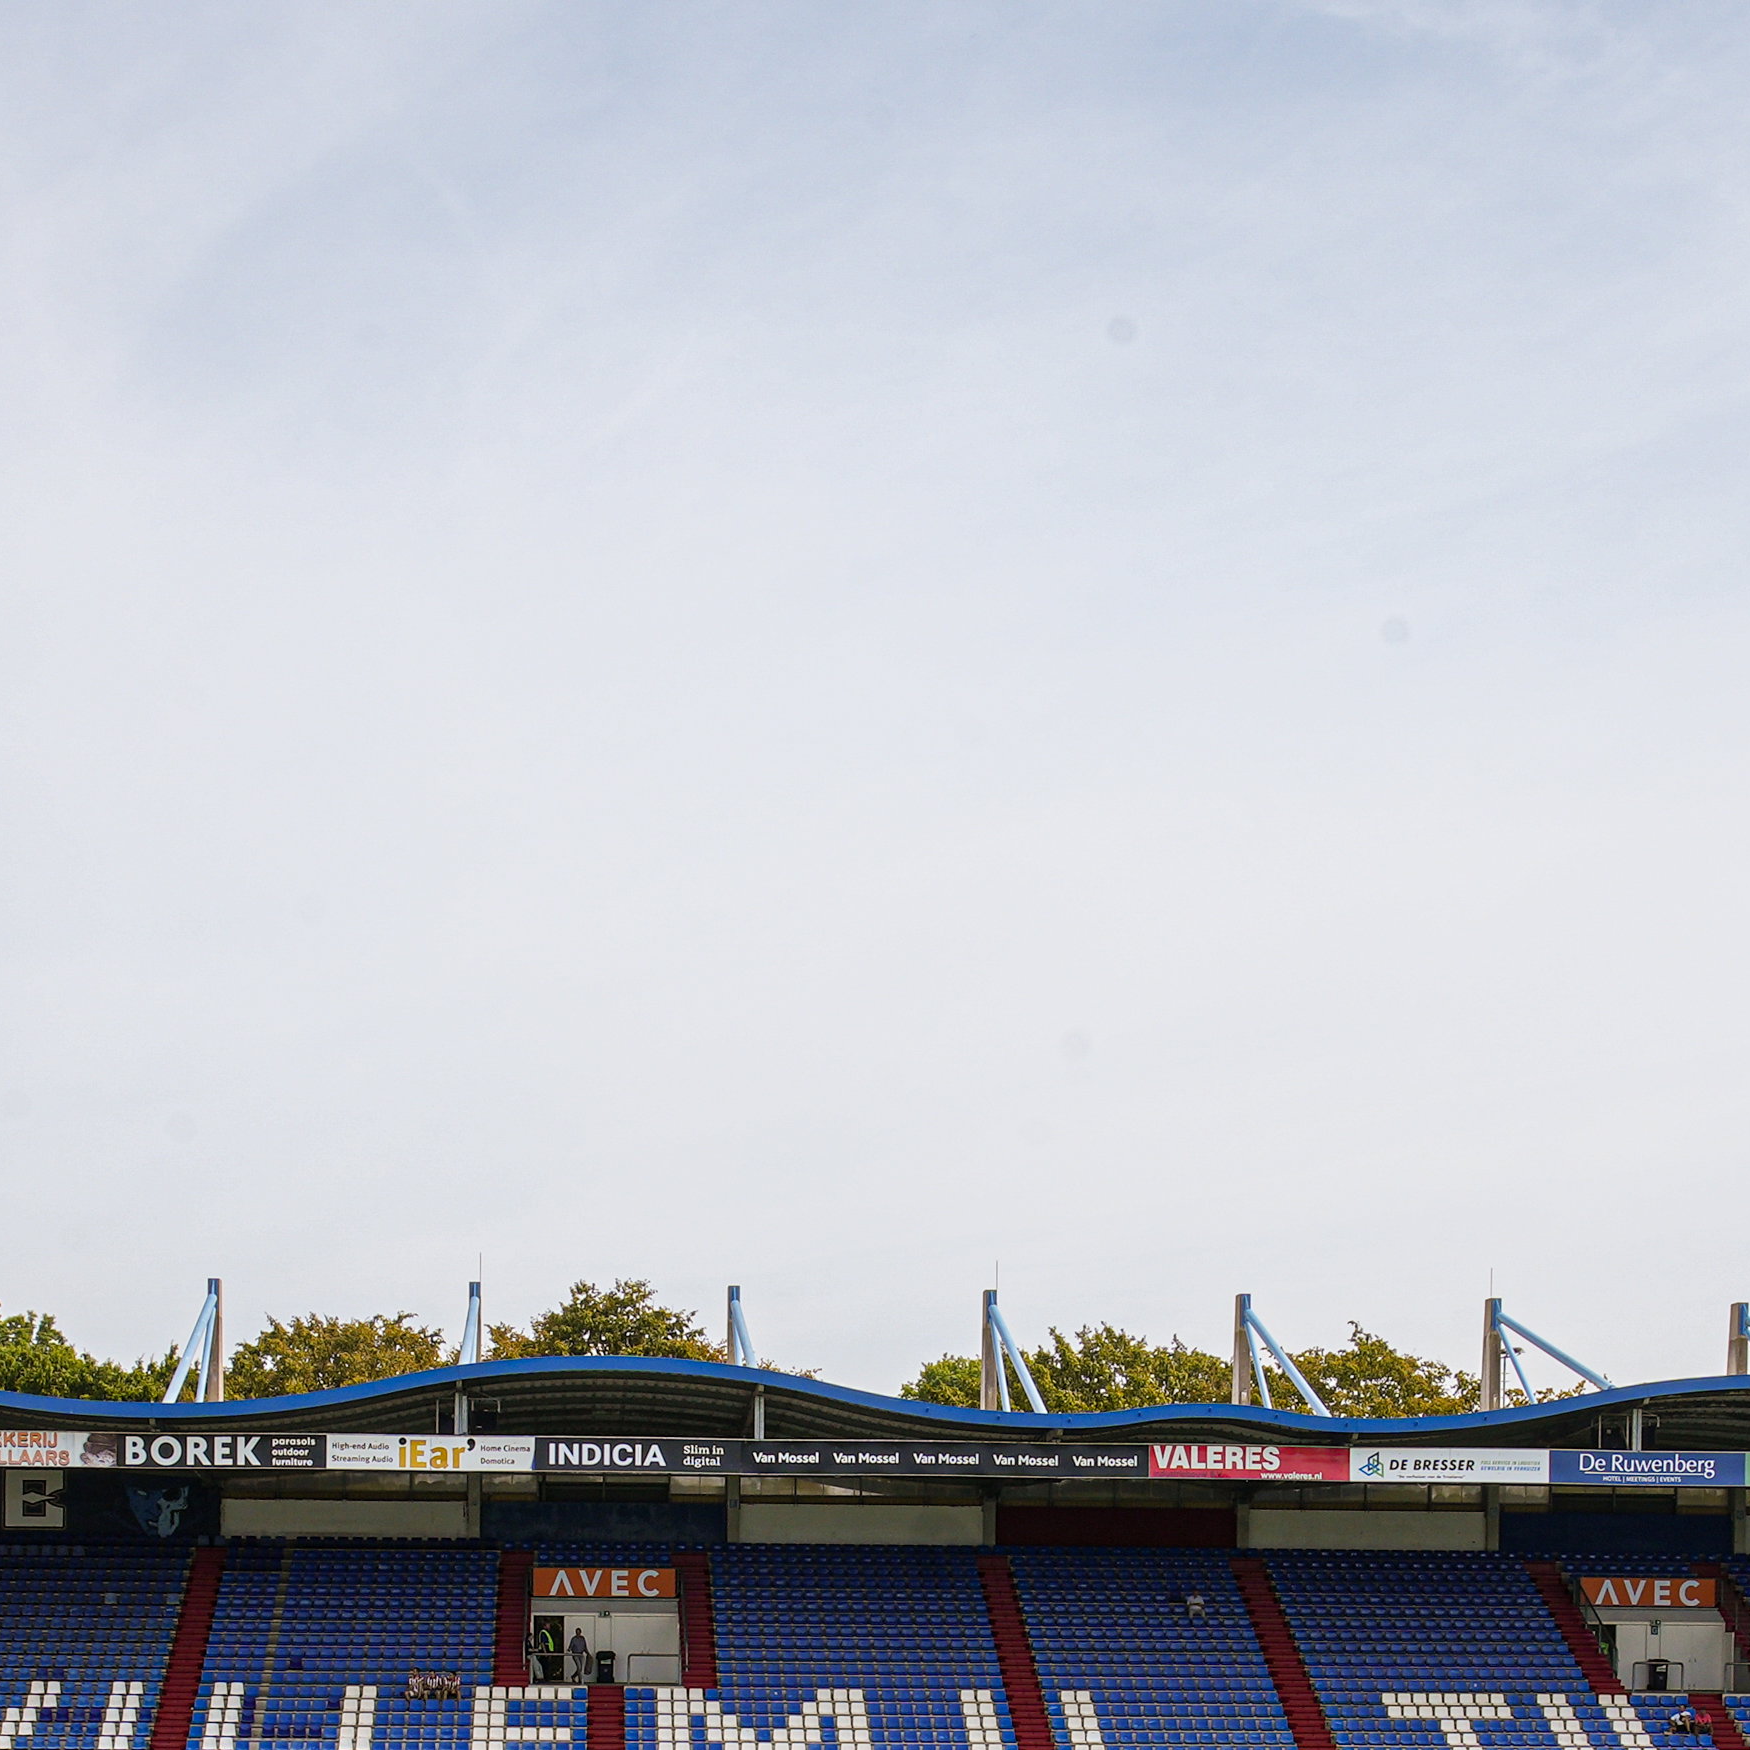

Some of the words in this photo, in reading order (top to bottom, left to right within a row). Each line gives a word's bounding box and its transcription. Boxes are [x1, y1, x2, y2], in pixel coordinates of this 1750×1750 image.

[271, 1436, 317, 1447] parasols
[331, 1441, 367, 1453] High-end
[367, 1441, 390, 1451] Audio
[124, 1435, 262, 1467] BOREK
[271, 1446, 309, 1457] outdoor
[479, 1444, 502, 1454] Home
[503, 1444, 532, 1454] Cinema
[547, 1442, 667, 1467] INDICIA
[683, 1444, 710, 1455] Slim
[712, 1445, 725, 1456] in
[271, 1456, 314, 1467] furniture
[331, 1454, 370, 1466] Streaming
[370, 1454, 394, 1465] Audio
[479, 1456, 516, 1467] Domotica
[683, 1456, 722, 1469] digital
[992, 1454, 1016, 1466] Van
[1017, 1454, 1059, 1467] Mossel
[1153, 1445, 1282, 1471] VALERES
[1389, 1459, 1410, 1471] DE
[1412, 1459, 1476, 1472] BRESSER
[1578, 1453, 1611, 1472] De
[1613, 1453, 1716, 1479] Ruwenberg
[1260, 1471, 1323, 1482] www.valeres.nl
[549, 1569, 661, 1597] AVEC
